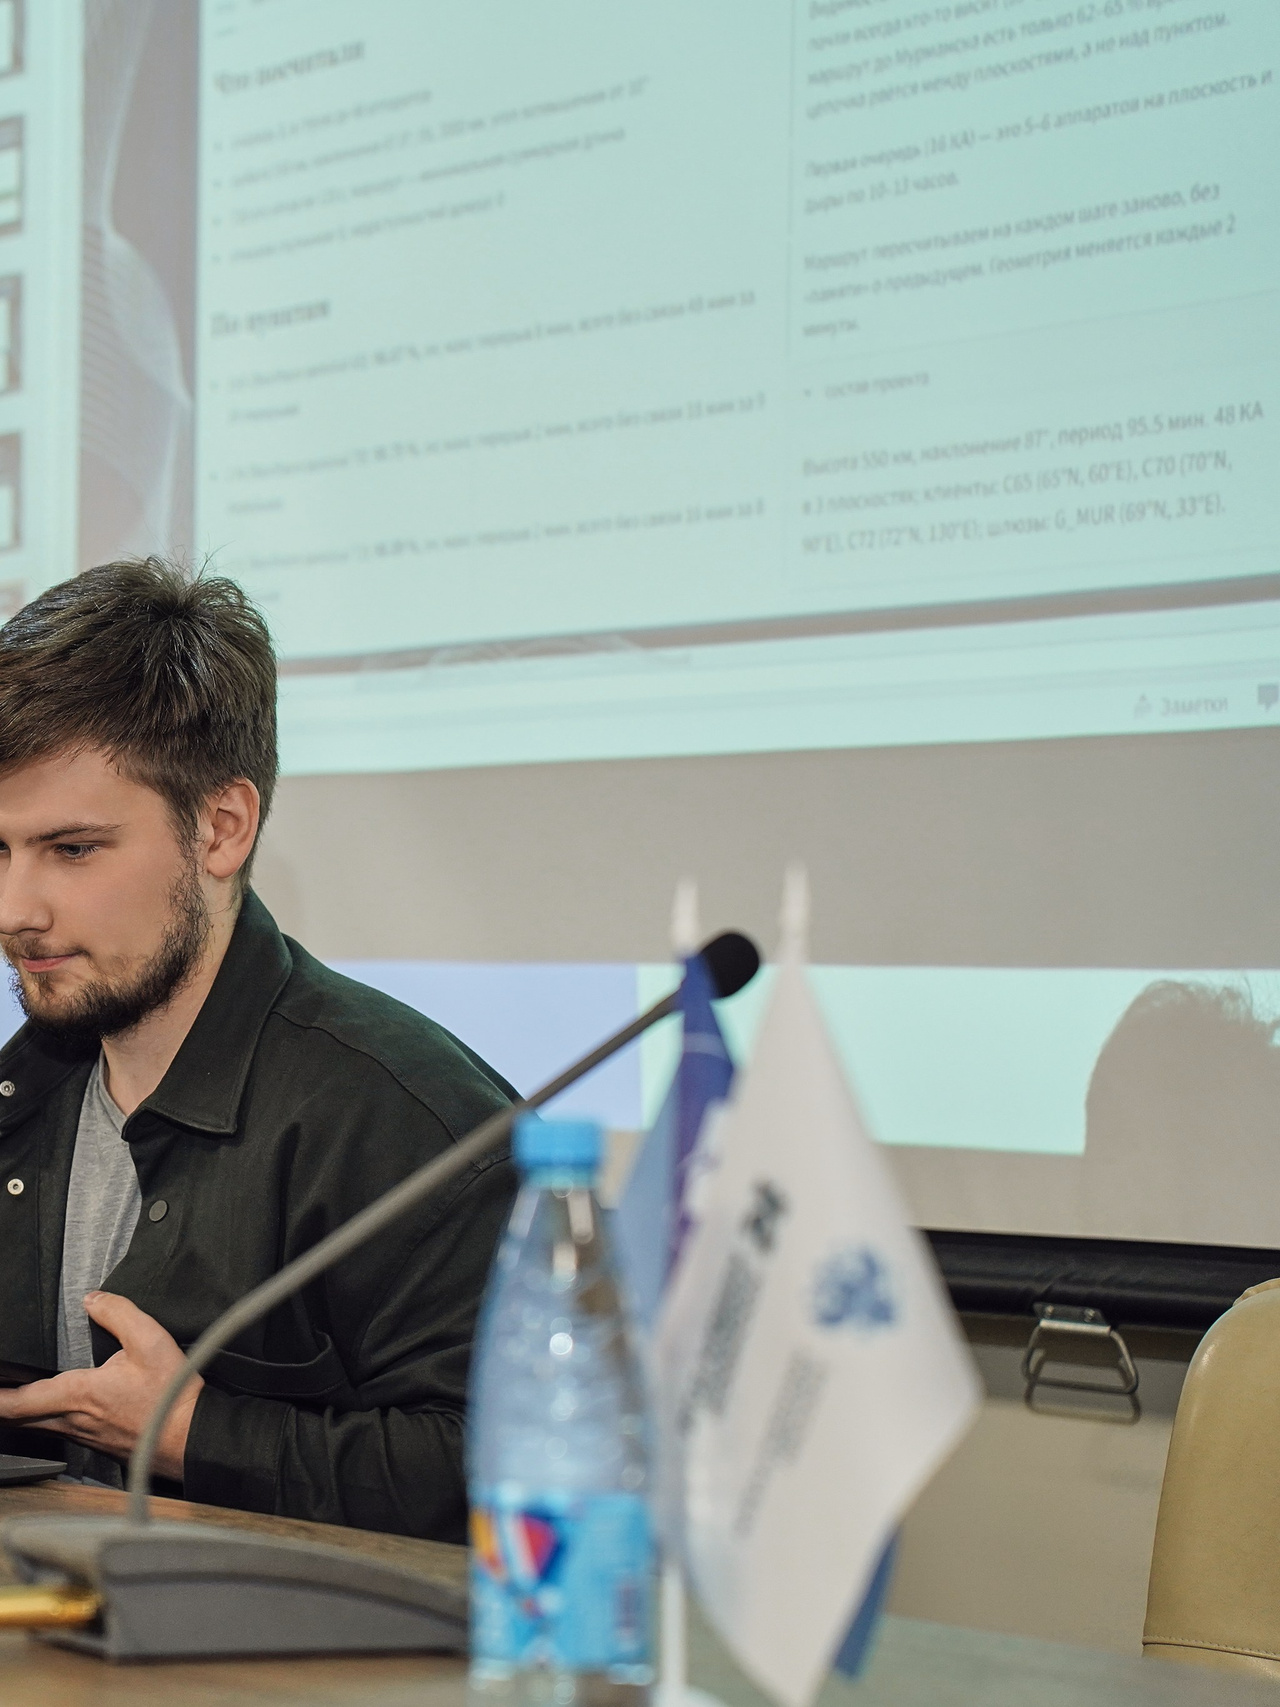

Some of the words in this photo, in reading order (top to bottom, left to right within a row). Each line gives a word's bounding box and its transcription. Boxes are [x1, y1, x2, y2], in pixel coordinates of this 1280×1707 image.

[1143, 95, 1166, 109] на
[1167, 76, 1258, 105] плоскость
[1260, 71, 1274, 86] и
[1188, 184, 1222, 203] без
[1225, 211, 1237, 236] 2
[1057, 424, 1124, 446] период
[1213, 406, 1236, 425] 48
[1238, 402, 1265, 422] КА
